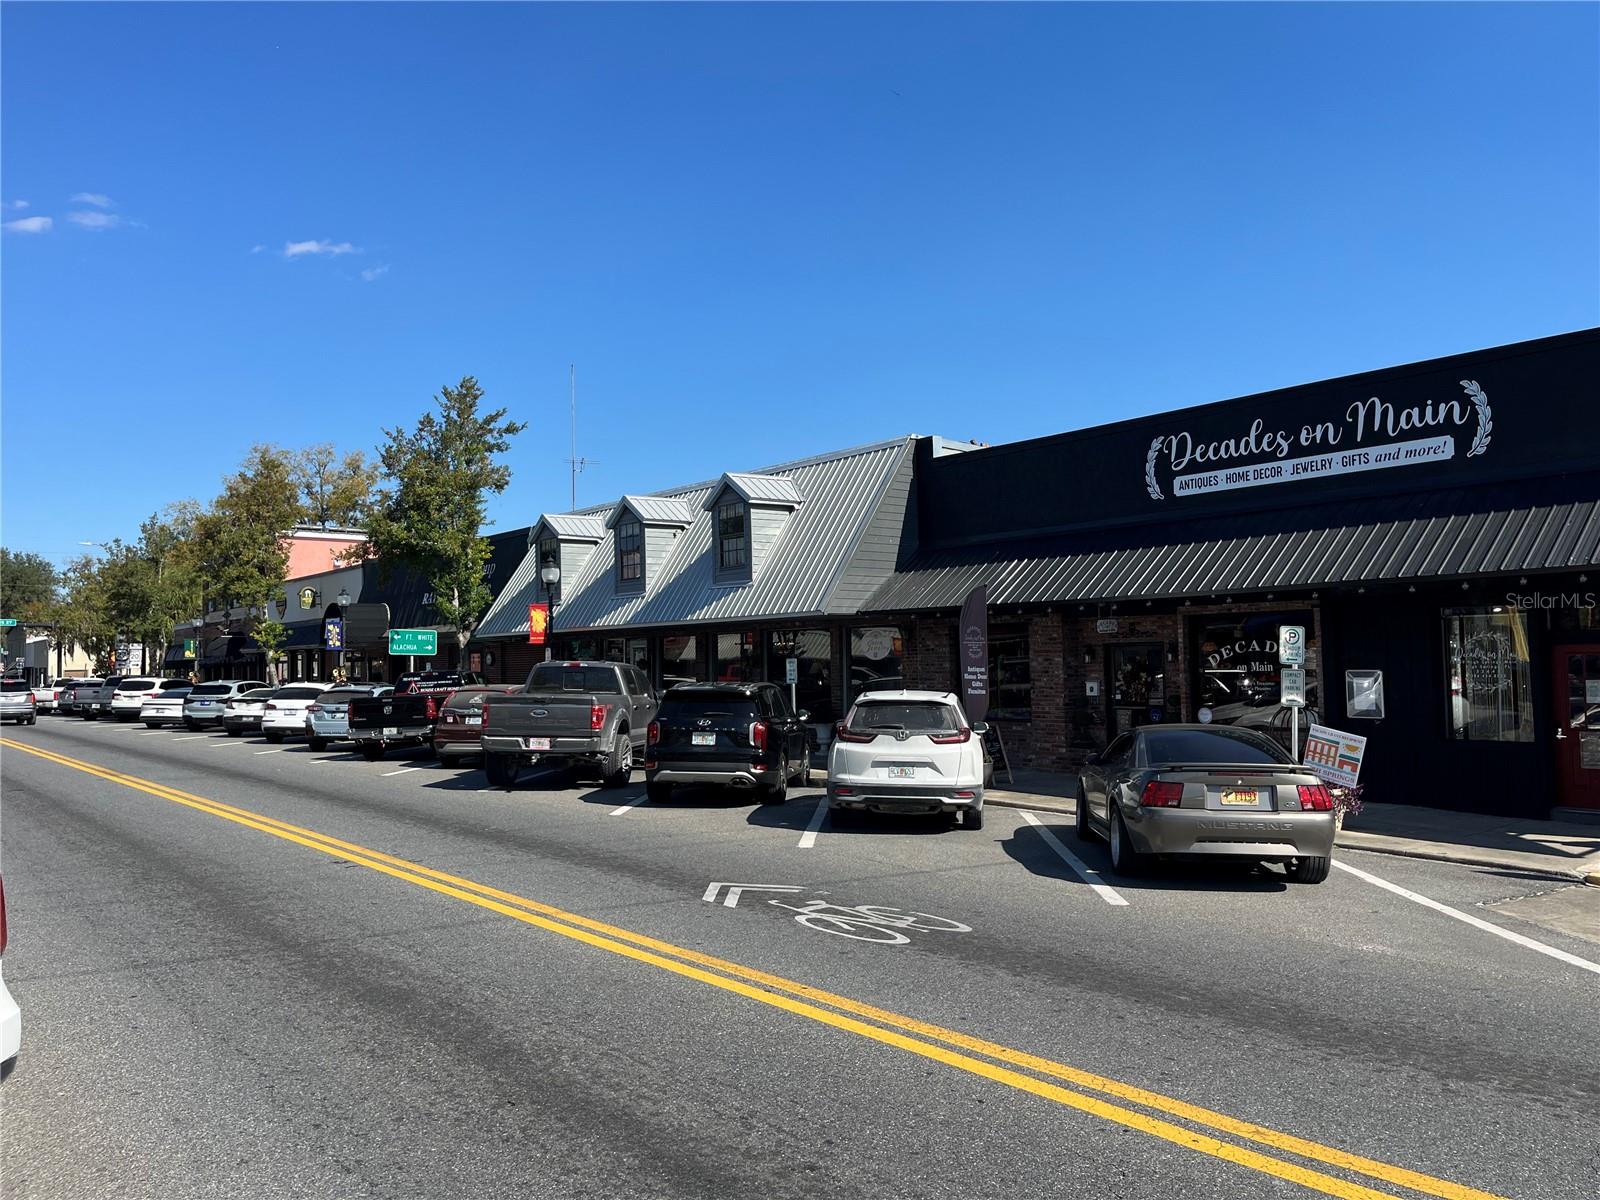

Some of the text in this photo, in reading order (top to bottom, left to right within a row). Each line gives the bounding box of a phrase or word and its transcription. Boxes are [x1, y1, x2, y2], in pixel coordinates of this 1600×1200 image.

[1163, 397, 1470, 471] Decades on Main
[1178, 440, 1448, 491] ANTIQUES HOME DECOR JEWELRY GIFTS and more!
[1207, 639, 1278, 669] DECAD
[1236, 661, 1274, 673] on Main
[1196, 821, 1294, 831] MUSTANG
